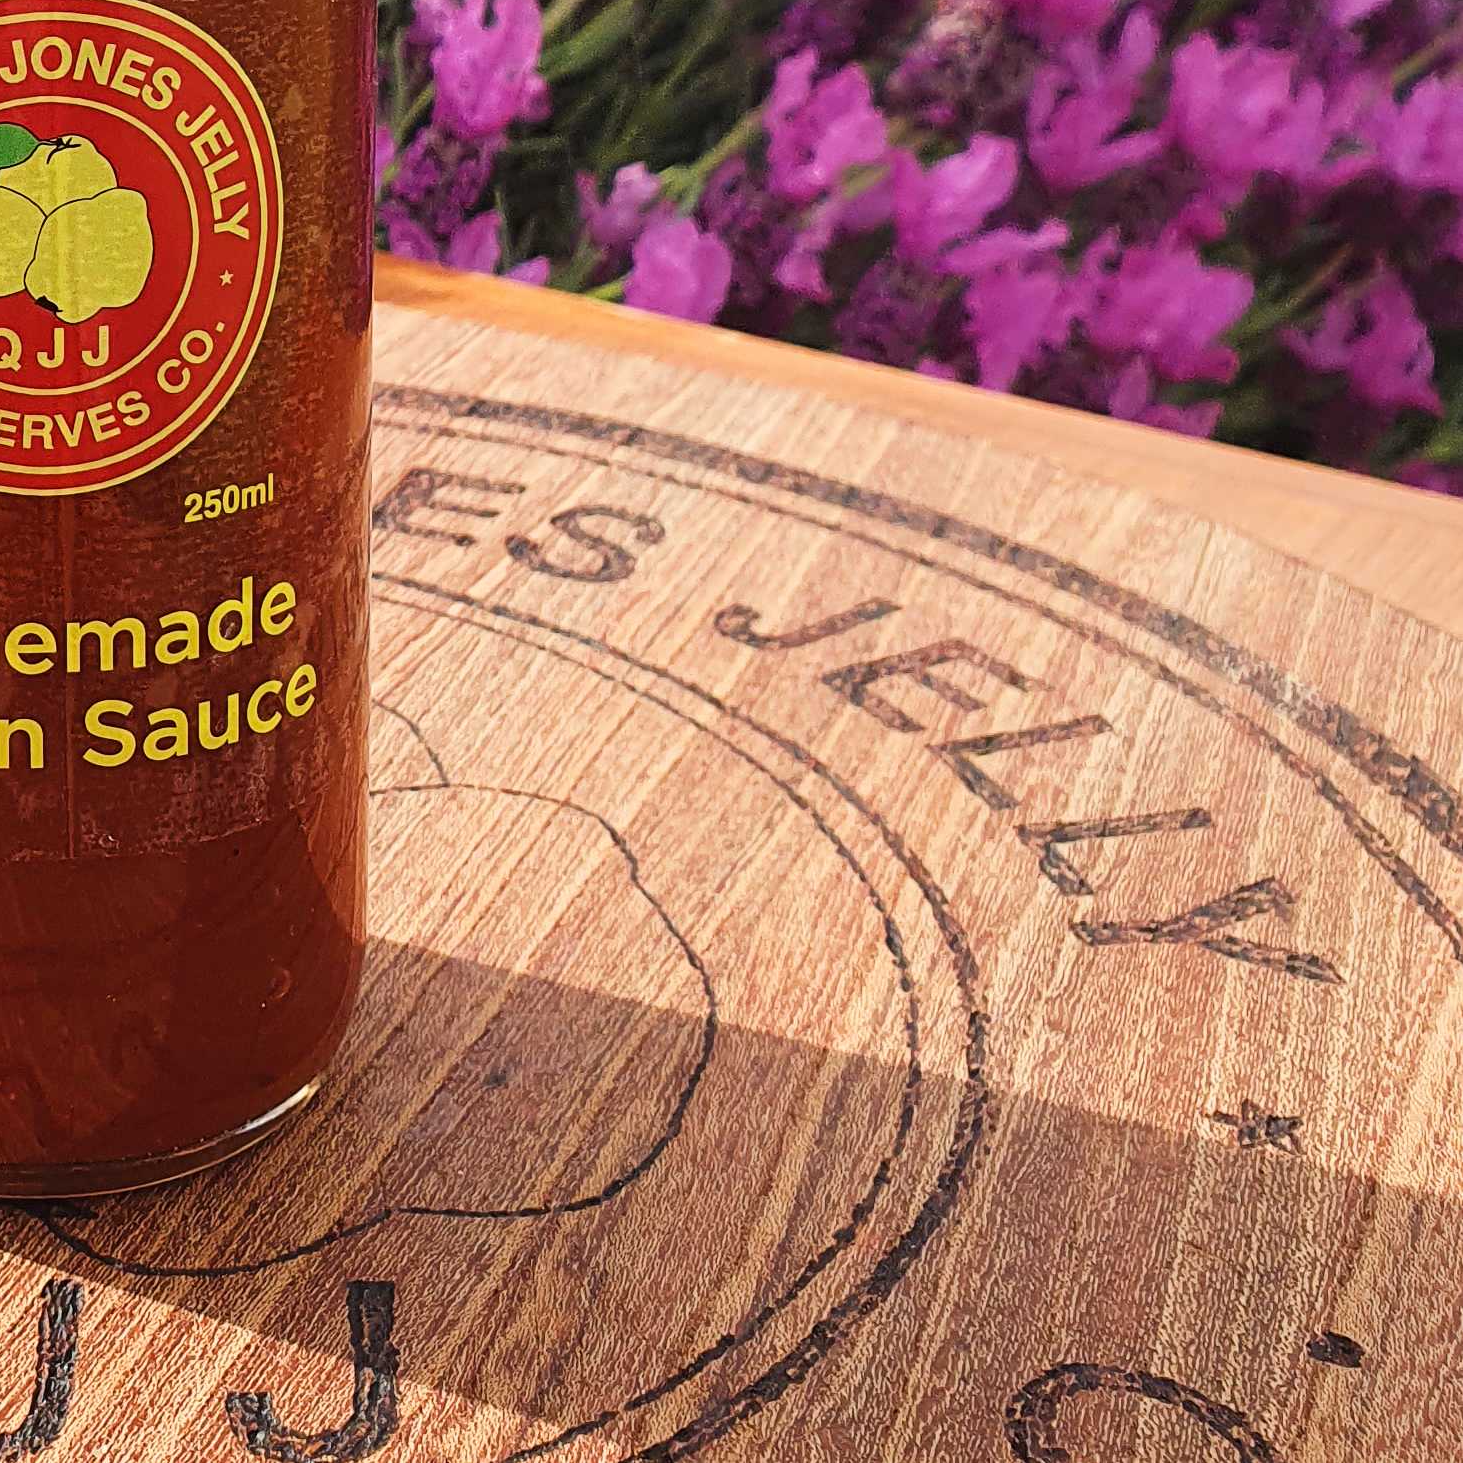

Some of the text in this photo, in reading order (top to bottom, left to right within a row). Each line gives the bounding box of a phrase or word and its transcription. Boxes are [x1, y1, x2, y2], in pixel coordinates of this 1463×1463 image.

[0, 36, 181, 111] JONES
[175, 105, 250, 240] JELLY
[156, 321, 226, 394] CO.
[184, 473, 275, 523] 250ml
[82, 663, 318, 768] Sauce
[713, 597, 1343, 983] JELLY
